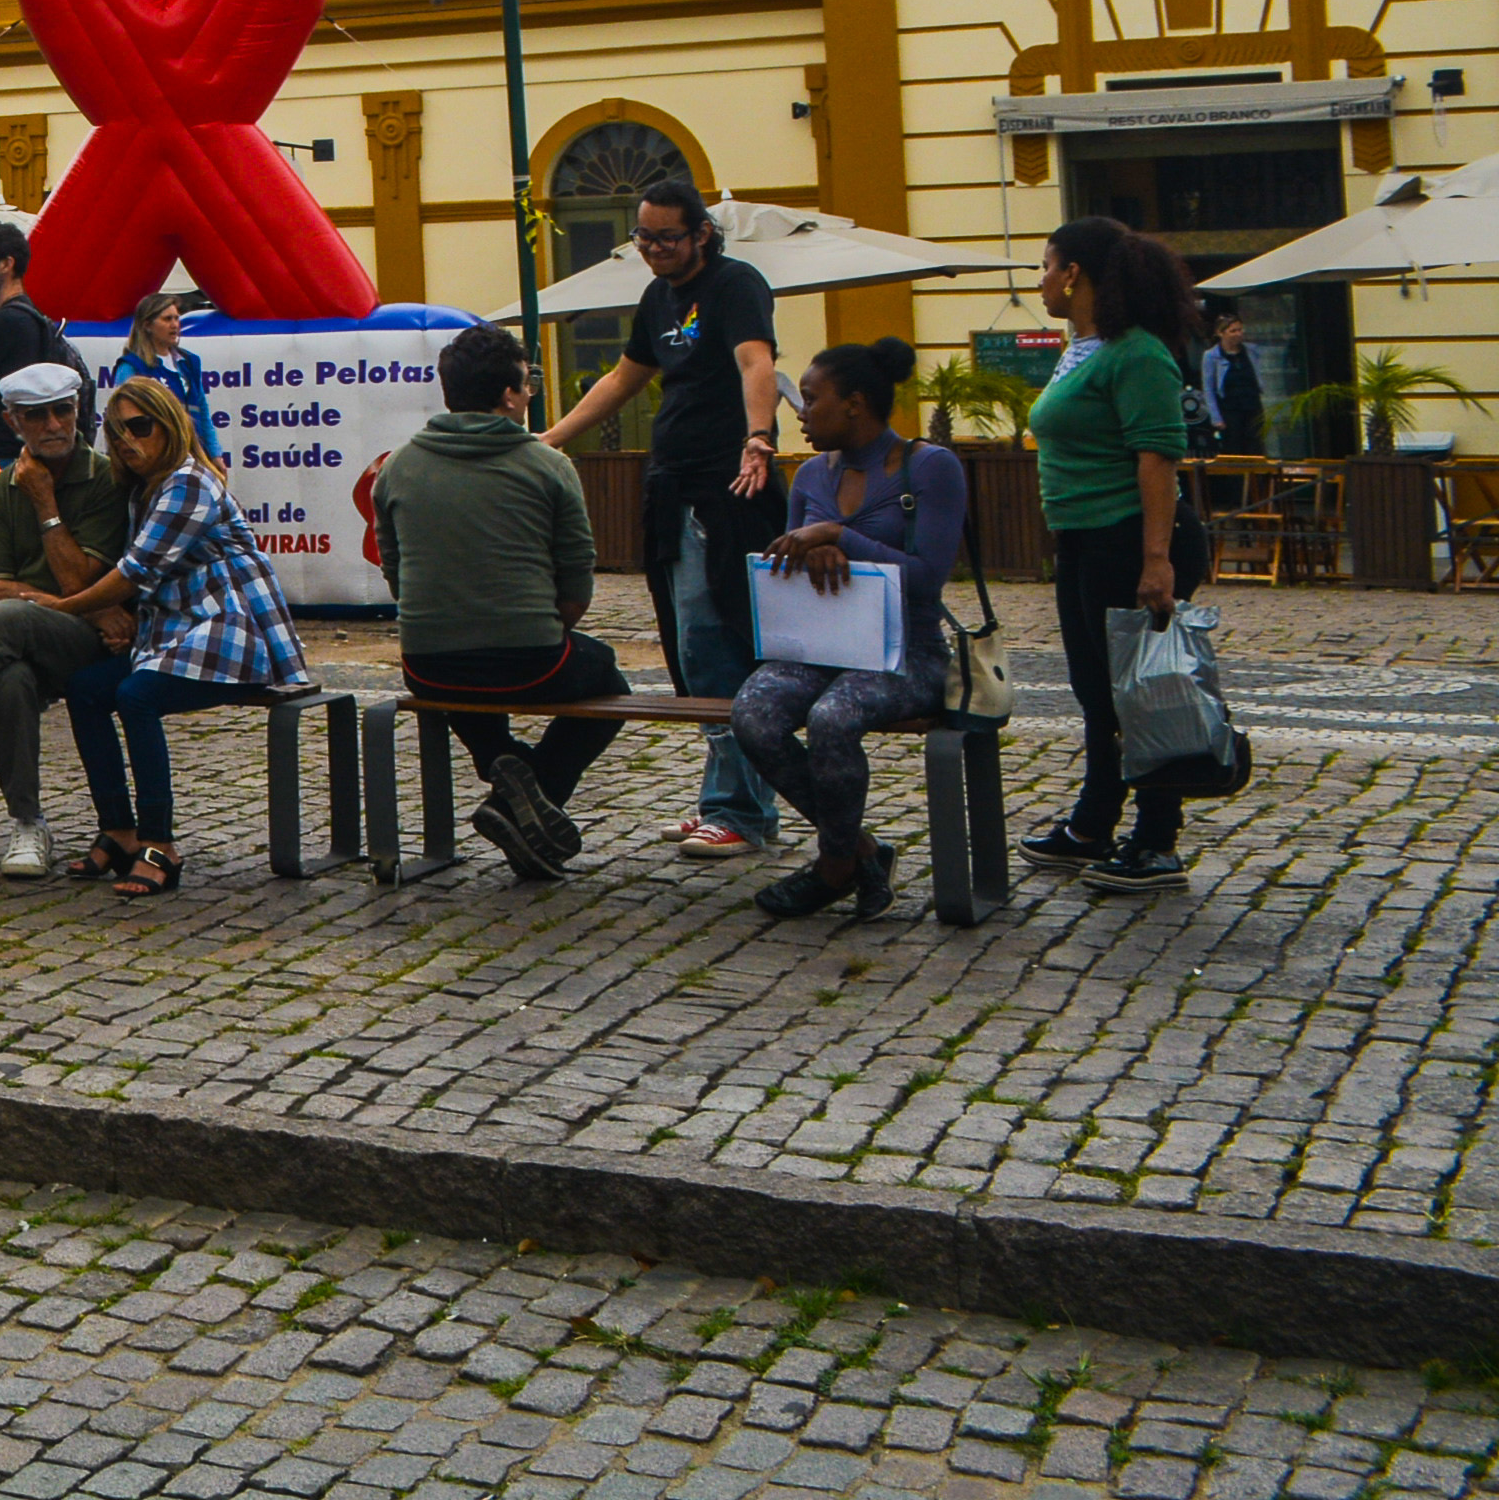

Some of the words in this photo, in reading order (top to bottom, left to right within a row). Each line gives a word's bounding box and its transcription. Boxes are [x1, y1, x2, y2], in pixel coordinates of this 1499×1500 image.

[1108, 114, 1145, 127] REST
[1148, 111, 1206, 125] CAVALO
[1208, 108, 1272, 121] BRANCO
[264, 361, 304, 387] de
[315, 359, 436, 385] Pelotas
[240, 402, 342, 429] Saúde
[242, 442, 344, 469] Saúde
[277, 502, 306, 522] de
[254, 533, 331, 554] VIRAIS
